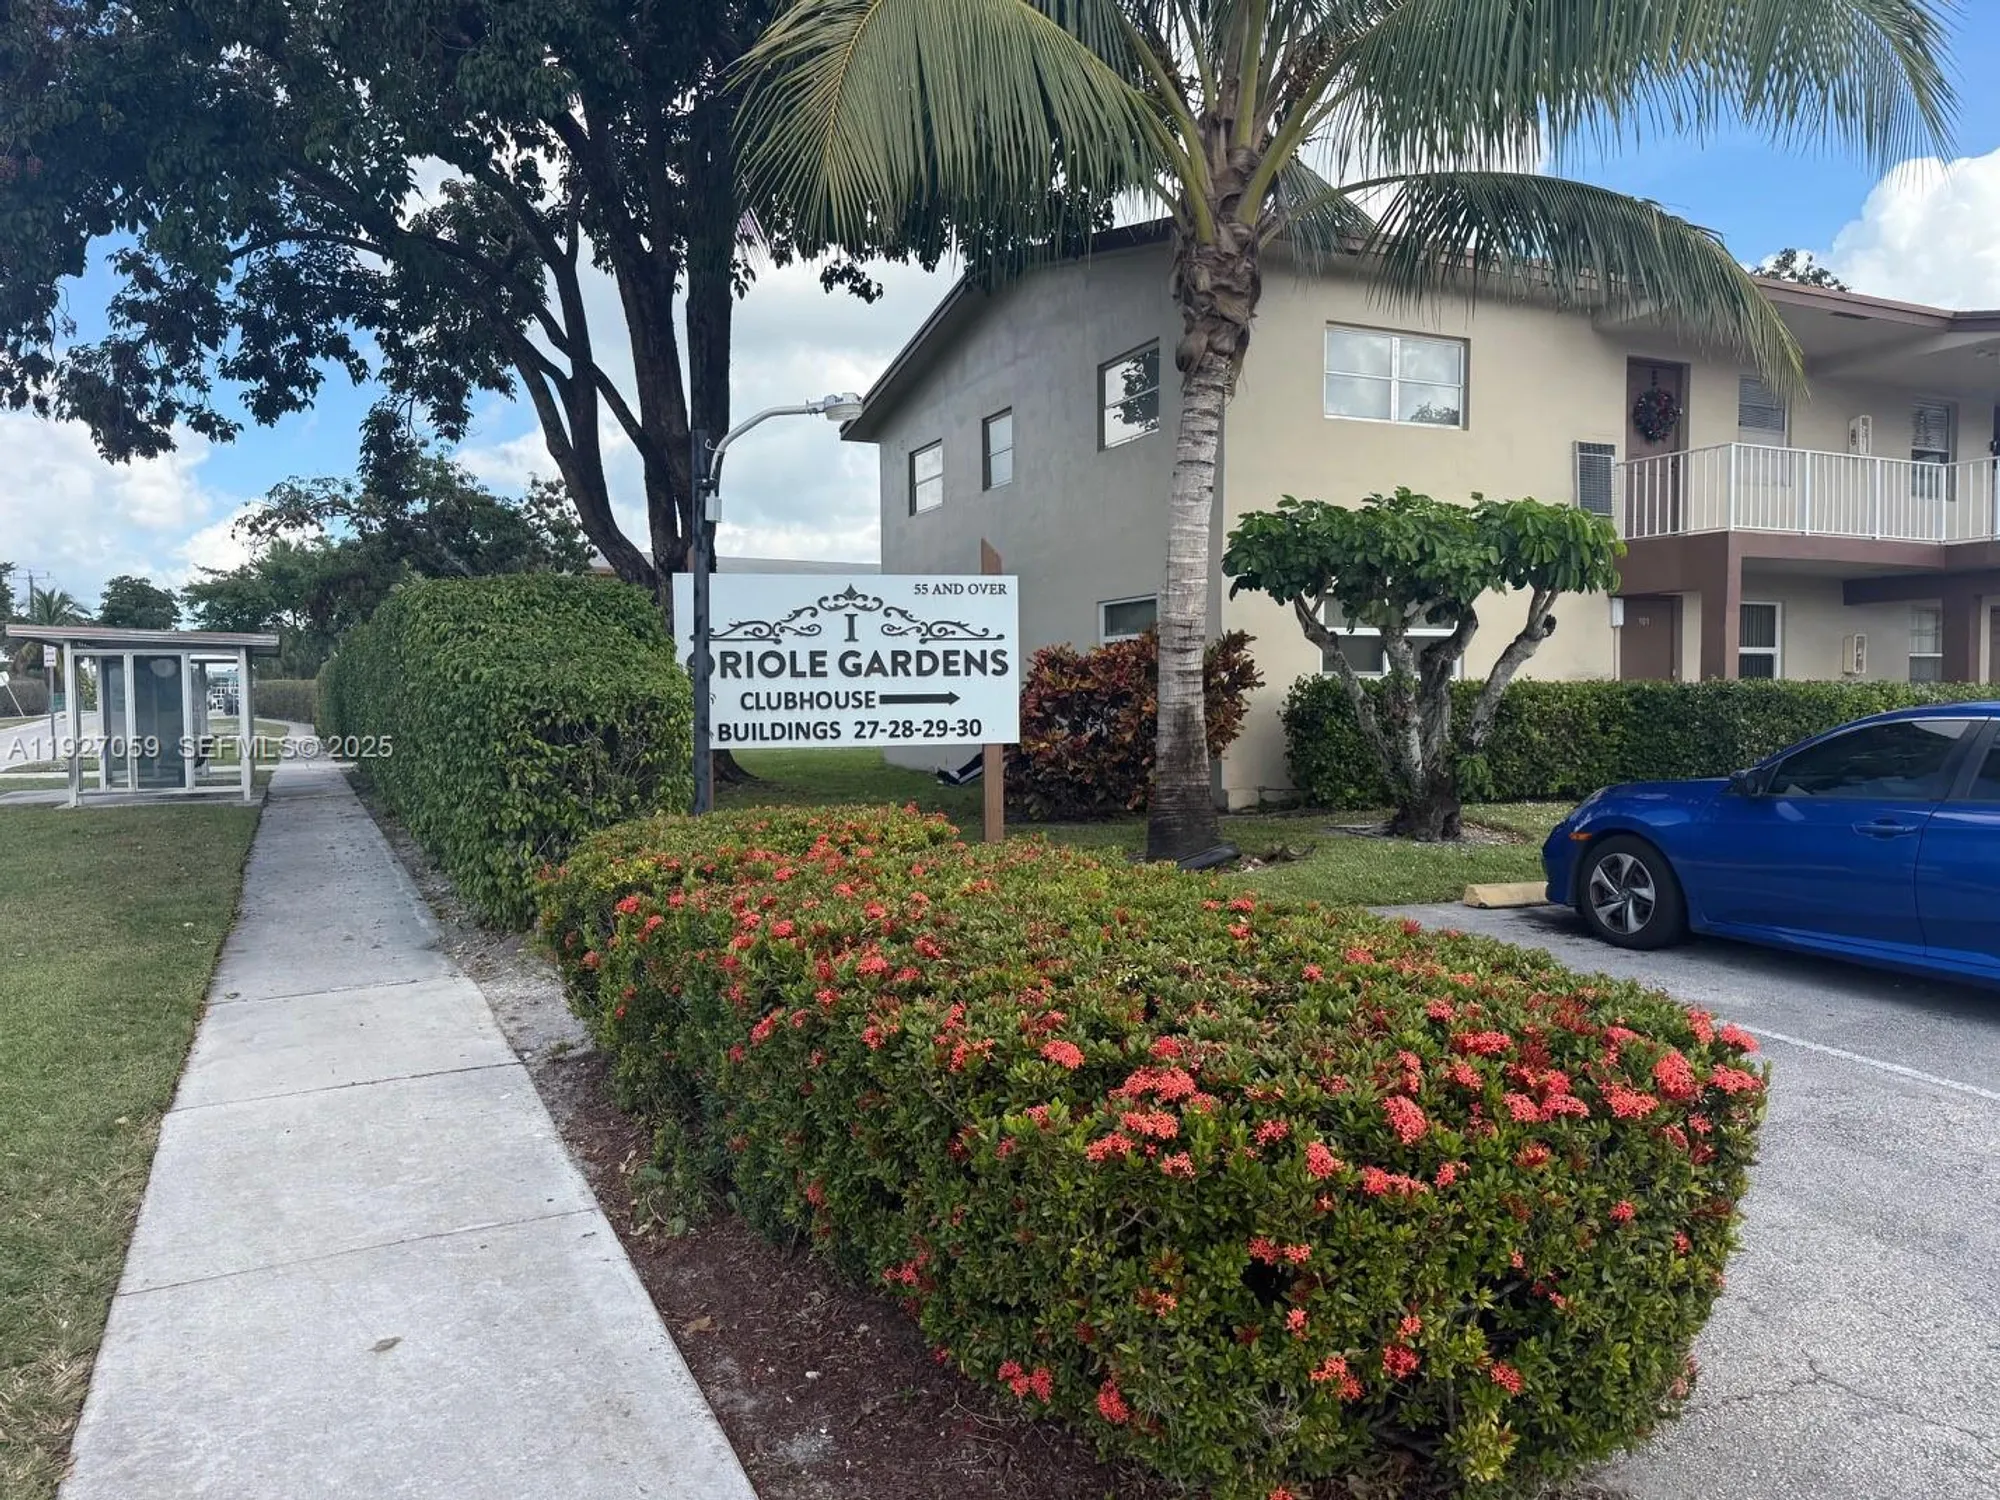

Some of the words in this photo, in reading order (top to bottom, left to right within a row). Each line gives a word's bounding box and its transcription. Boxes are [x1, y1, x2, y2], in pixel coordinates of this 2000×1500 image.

[913, 584, 928, 595] 55
[932, 583, 964, 595] AND
[967, 583, 1007, 596] OVER
[844, 613, 859, 642] I
[838, 649, 1009, 678] GARDENS
[740, 690, 876, 711] CLUBHOUSE
[717, 720, 841, 742] BUILDINGS
[854, 718, 982, 740] 27-28-29-30
